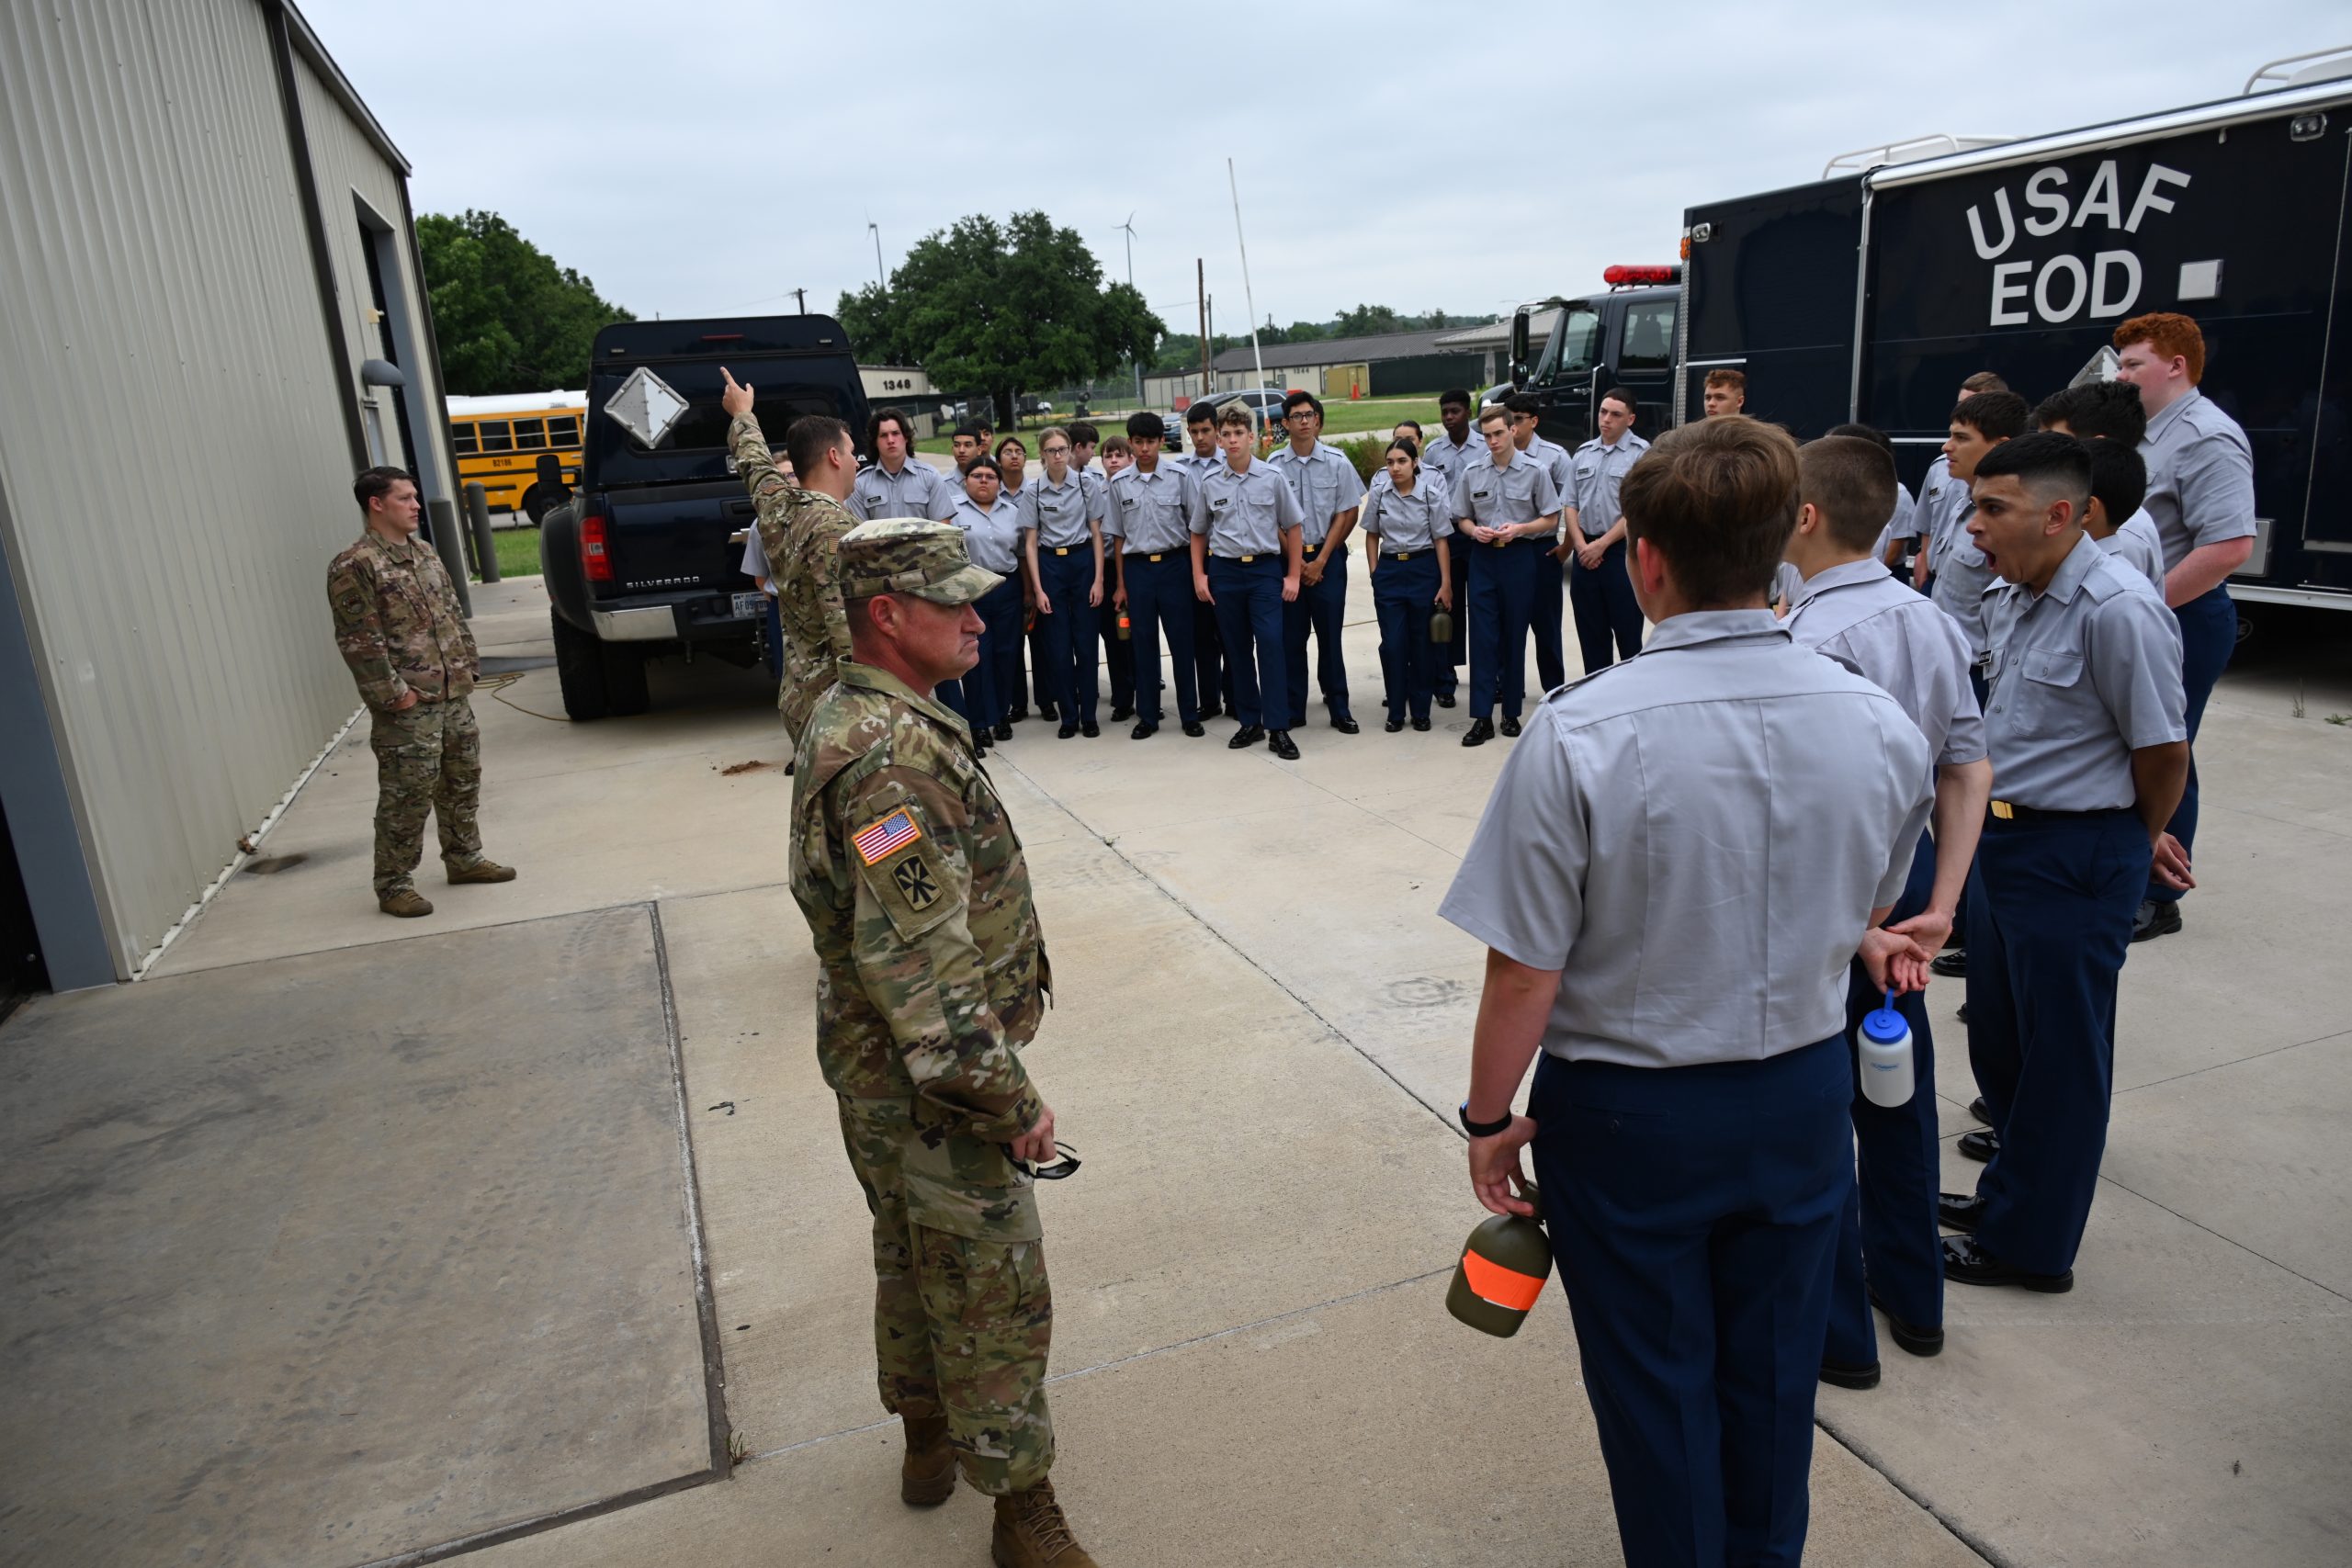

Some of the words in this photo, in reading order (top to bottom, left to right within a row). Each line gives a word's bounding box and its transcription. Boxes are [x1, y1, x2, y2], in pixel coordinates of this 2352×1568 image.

[1966, 160, 2192, 260] USAF
[1989, 249, 2143, 326] EOD
[883, 378, 910, 390] 1348
[627, 576, 699, 588] SILVERADO
